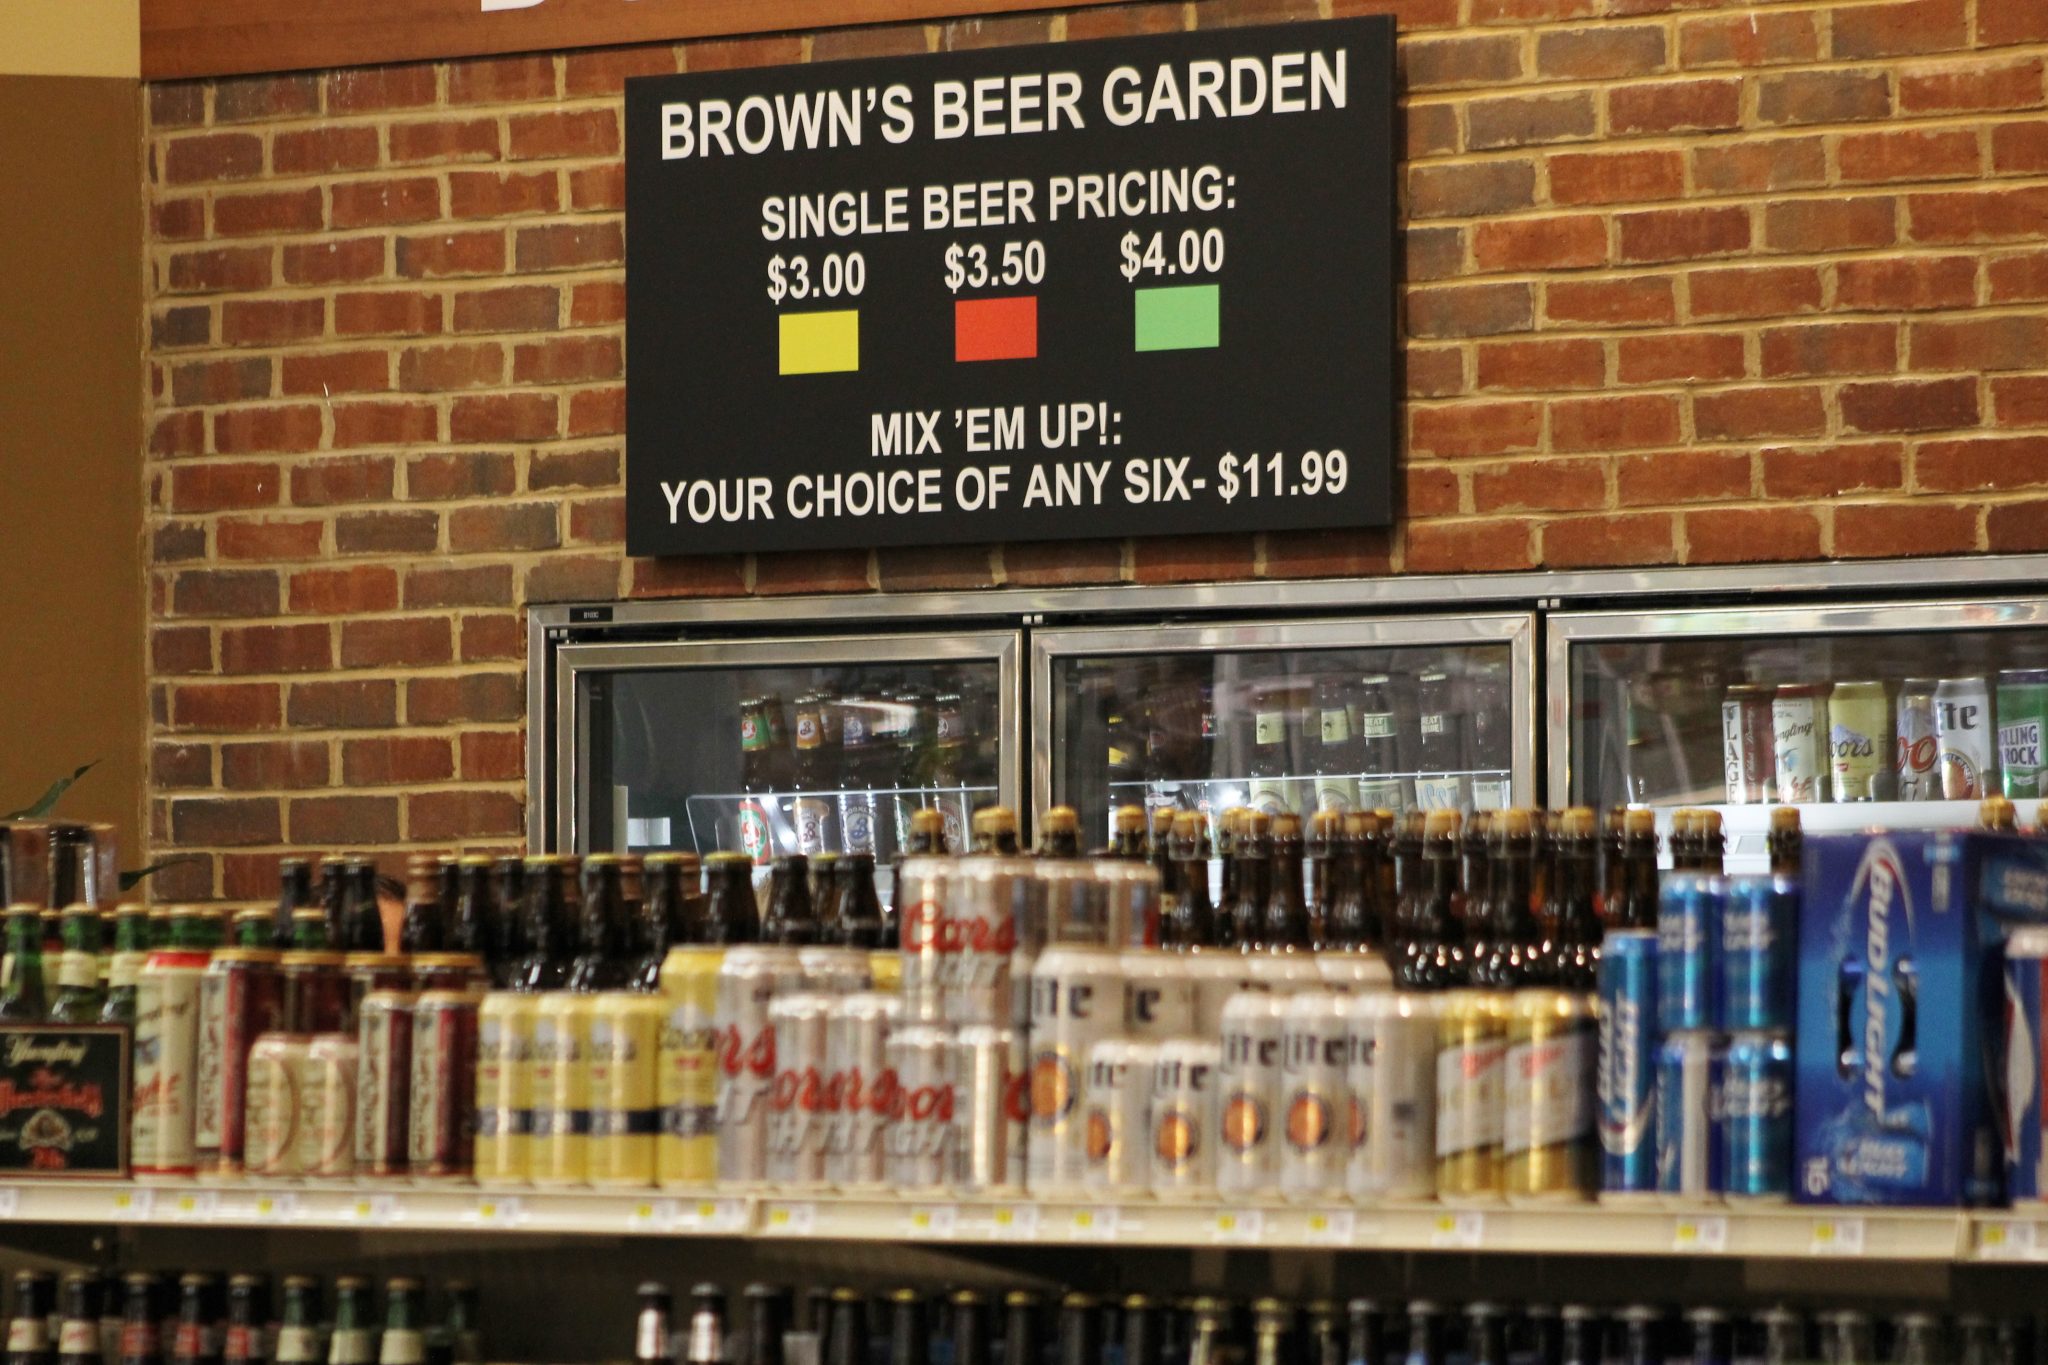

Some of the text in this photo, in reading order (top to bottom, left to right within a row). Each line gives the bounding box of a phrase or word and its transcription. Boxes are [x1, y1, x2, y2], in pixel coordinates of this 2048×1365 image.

[661, 48, 1347, 161] BROWN'S BEER GARDEN
[761, 164, 1237, 242] SINGLE BEER PRICING:
[766, 251, 867, 306] $3.00
[944, 239, 1047, 296] $3.50
[1119, 227, 1226, 284] $4.00
[871, 401, 1122, 458] MIX 'EM UP!:
[660, 448, 1348, 524] YOUR CHOICE OF ANY SIX- $11.99
[1831, 738, 1874, 758] oors
[1867, 860, 1894, 970] BUD
[1864, 970, 1889, 1127] LIGHT
